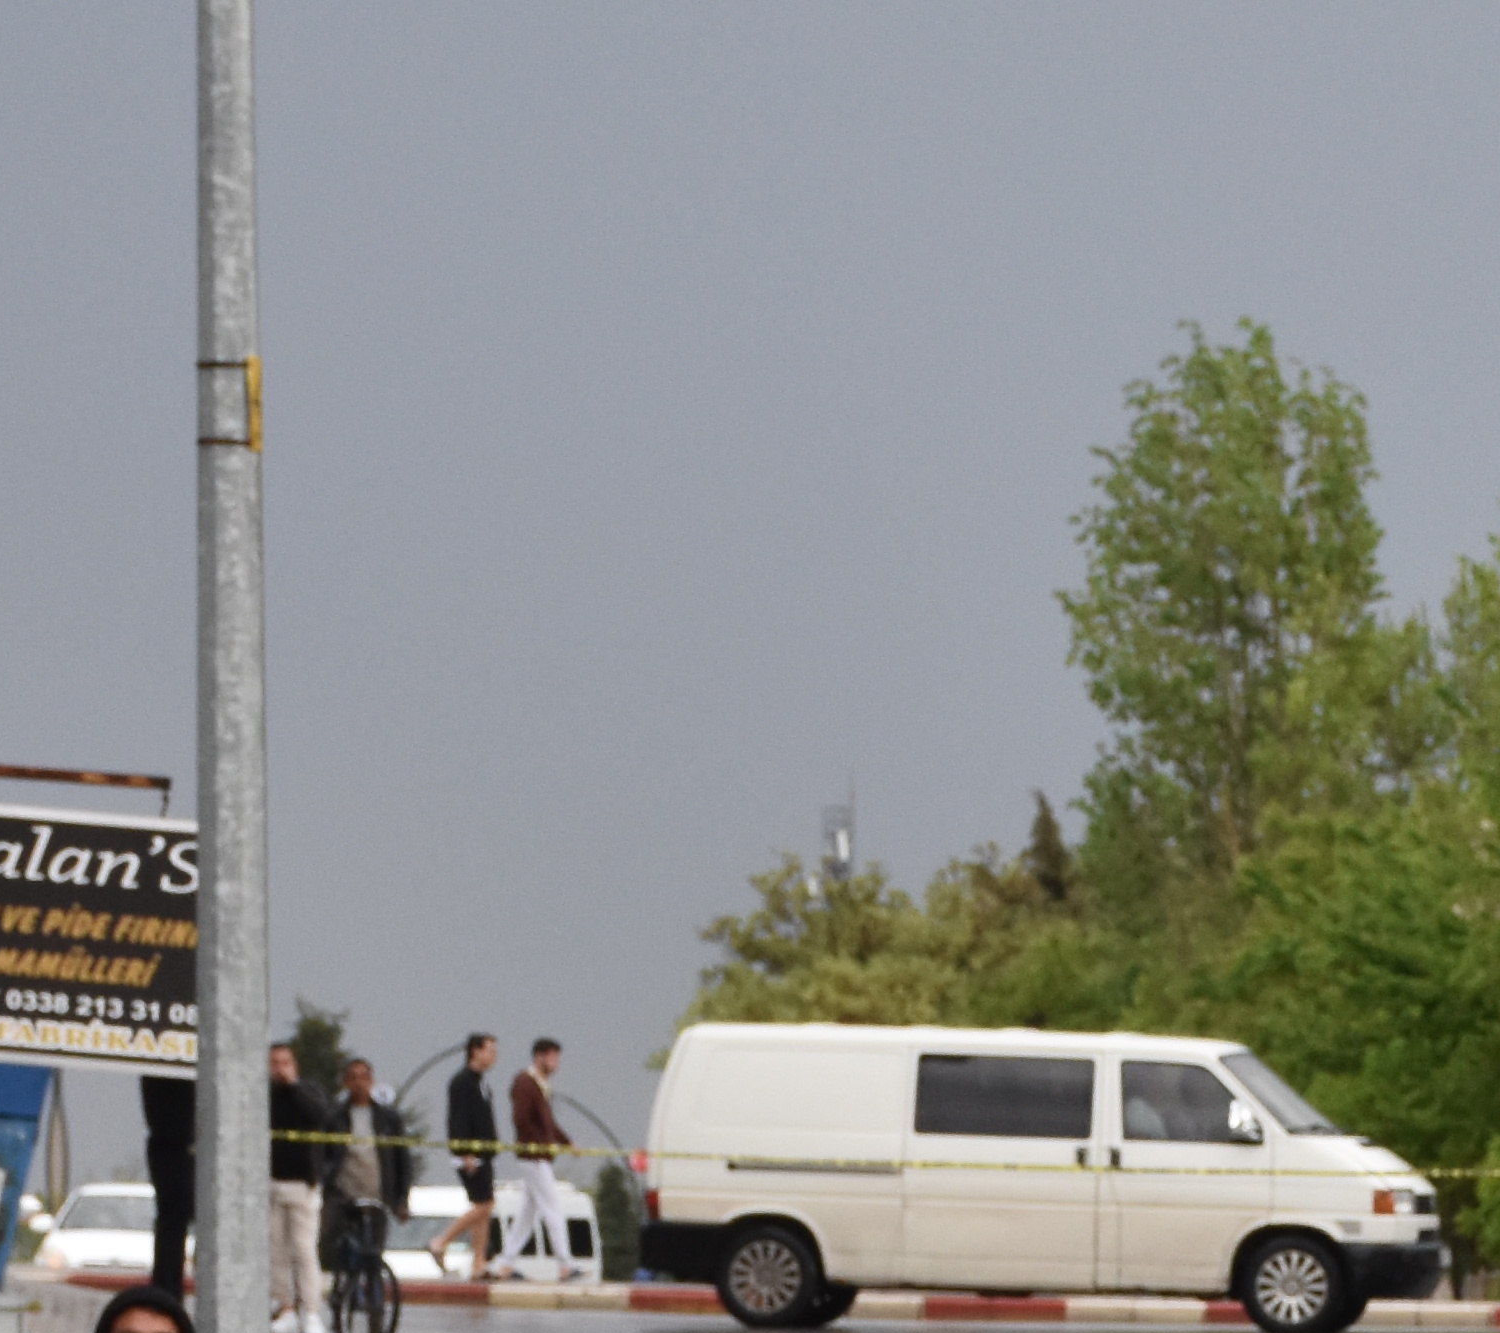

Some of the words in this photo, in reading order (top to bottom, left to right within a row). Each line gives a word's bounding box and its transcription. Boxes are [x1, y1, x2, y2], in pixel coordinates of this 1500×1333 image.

[2, 903, 41, 936] VE
[42, 901, 113, 941] PİDE
[5, 987, 70, 1015] 0338
[75, 993, 125, 1020] 213
[129, 998, 161, 1023] 31
